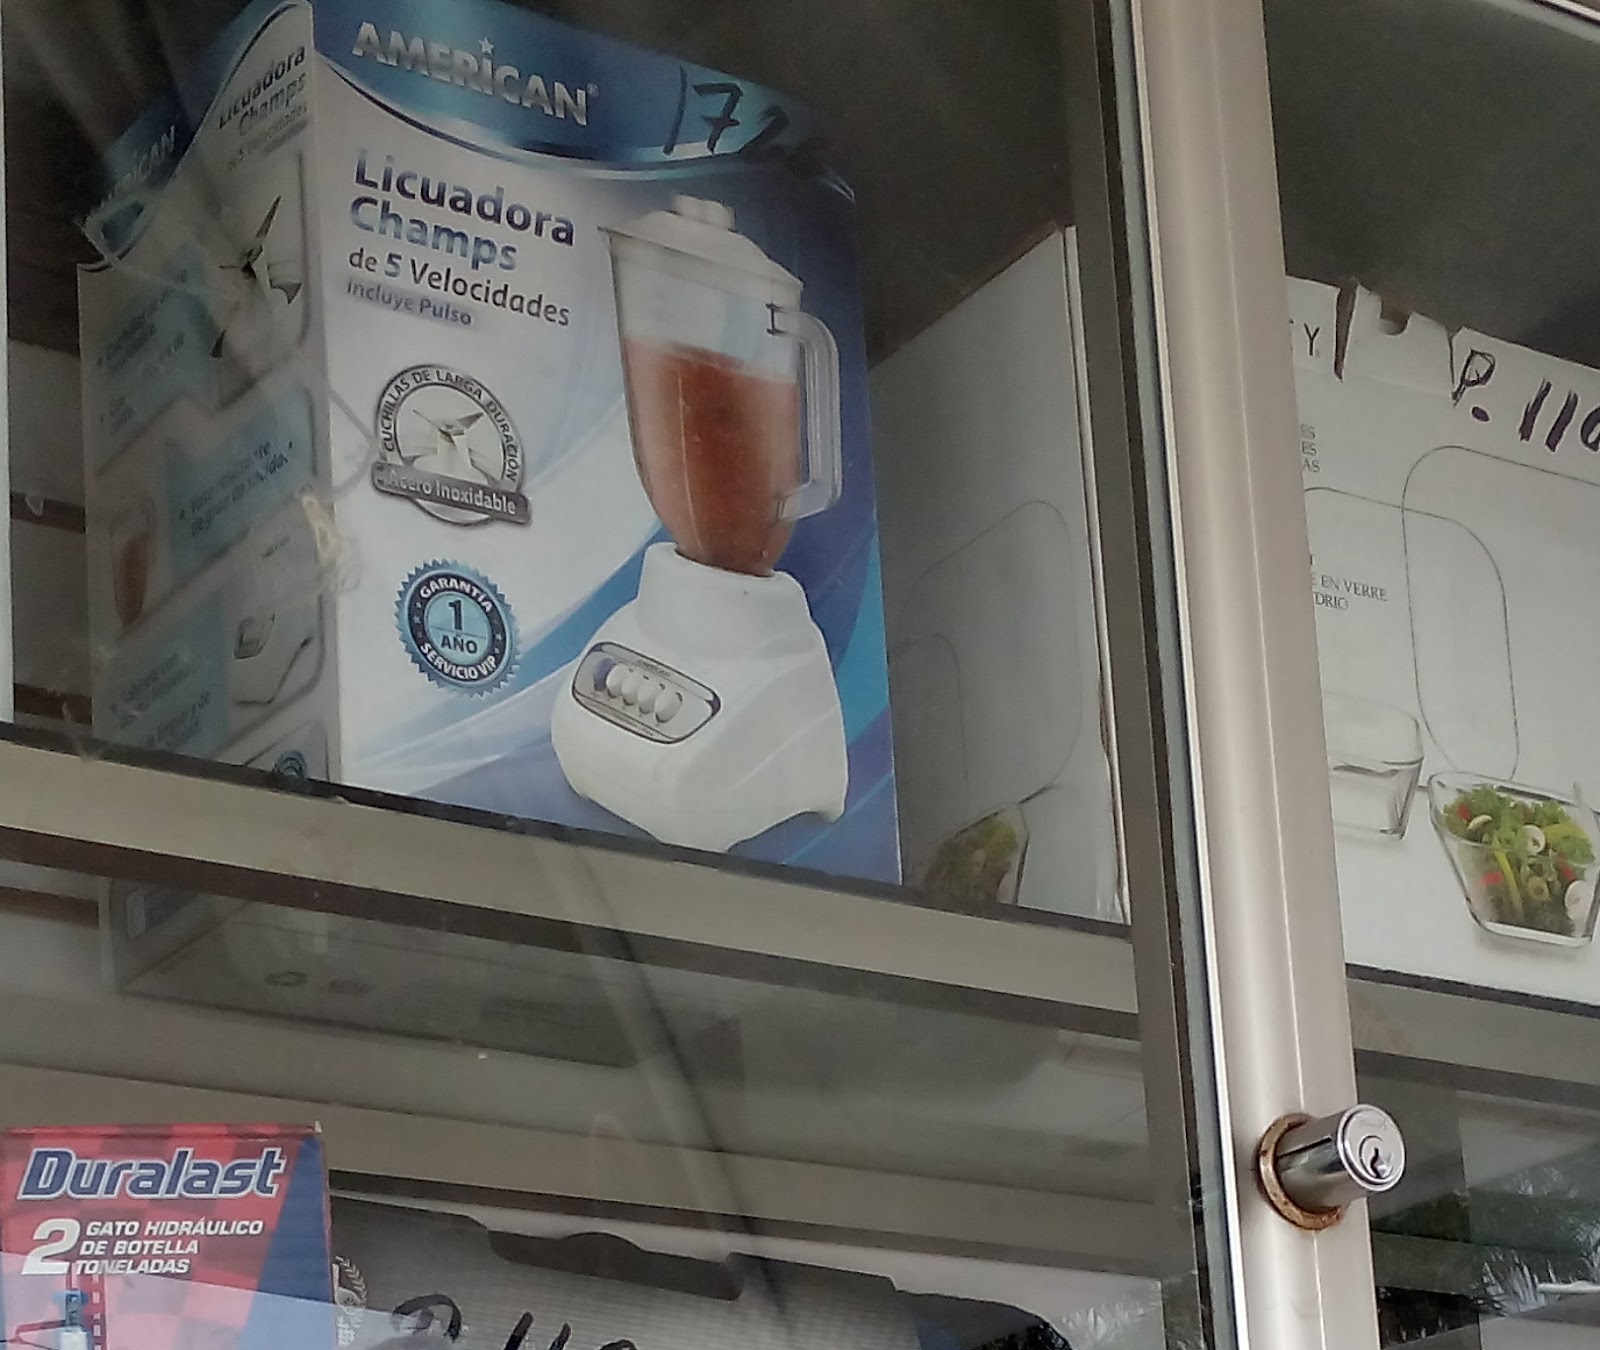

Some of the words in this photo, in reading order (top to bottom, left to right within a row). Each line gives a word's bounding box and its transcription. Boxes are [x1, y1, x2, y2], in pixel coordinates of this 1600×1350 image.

[352, 20, 588, 127] AMERICAN
[354, 149, 575, 247] Licuadora
[350, 196, 518, 271] Champs
[349, 247, 378, 273] de
[384, 252, 402, 278] 5
[410, 258, 571, 327] Velocidades
[419, 298, 473, 327] Pulso
[381, 379, 410, 453] CUCHILLAS
[412, 370, 432, 385] DE
[435, 370, 484, 400] LARGA
[436, 480, 517, 515] Inoxidable
[420, 577, 494, 613] GARANTÍA
[1313, 591, 1350, 611] DRIO
[1343, 579, 1388, 603] VERRE
[448, 599, 463, 632] 1
[420, 643, 479, 679] SERVICIO
[477, 655, 497, 676] VIP
[441, 632, 478, 654] AÑO
[17, 1147, 288, 1200] Duralast
[21, 1217, 81, 1276] 2
[85, 1220, 140, 1237] GATO
[144, 1216, 263, 1236] HIDRÁULICO
[79, 1240, 109, 1256] DE
[113, 1239, 199, 1256] BOTELLA
[75, 1258, 191, 1275] TONELADAS
